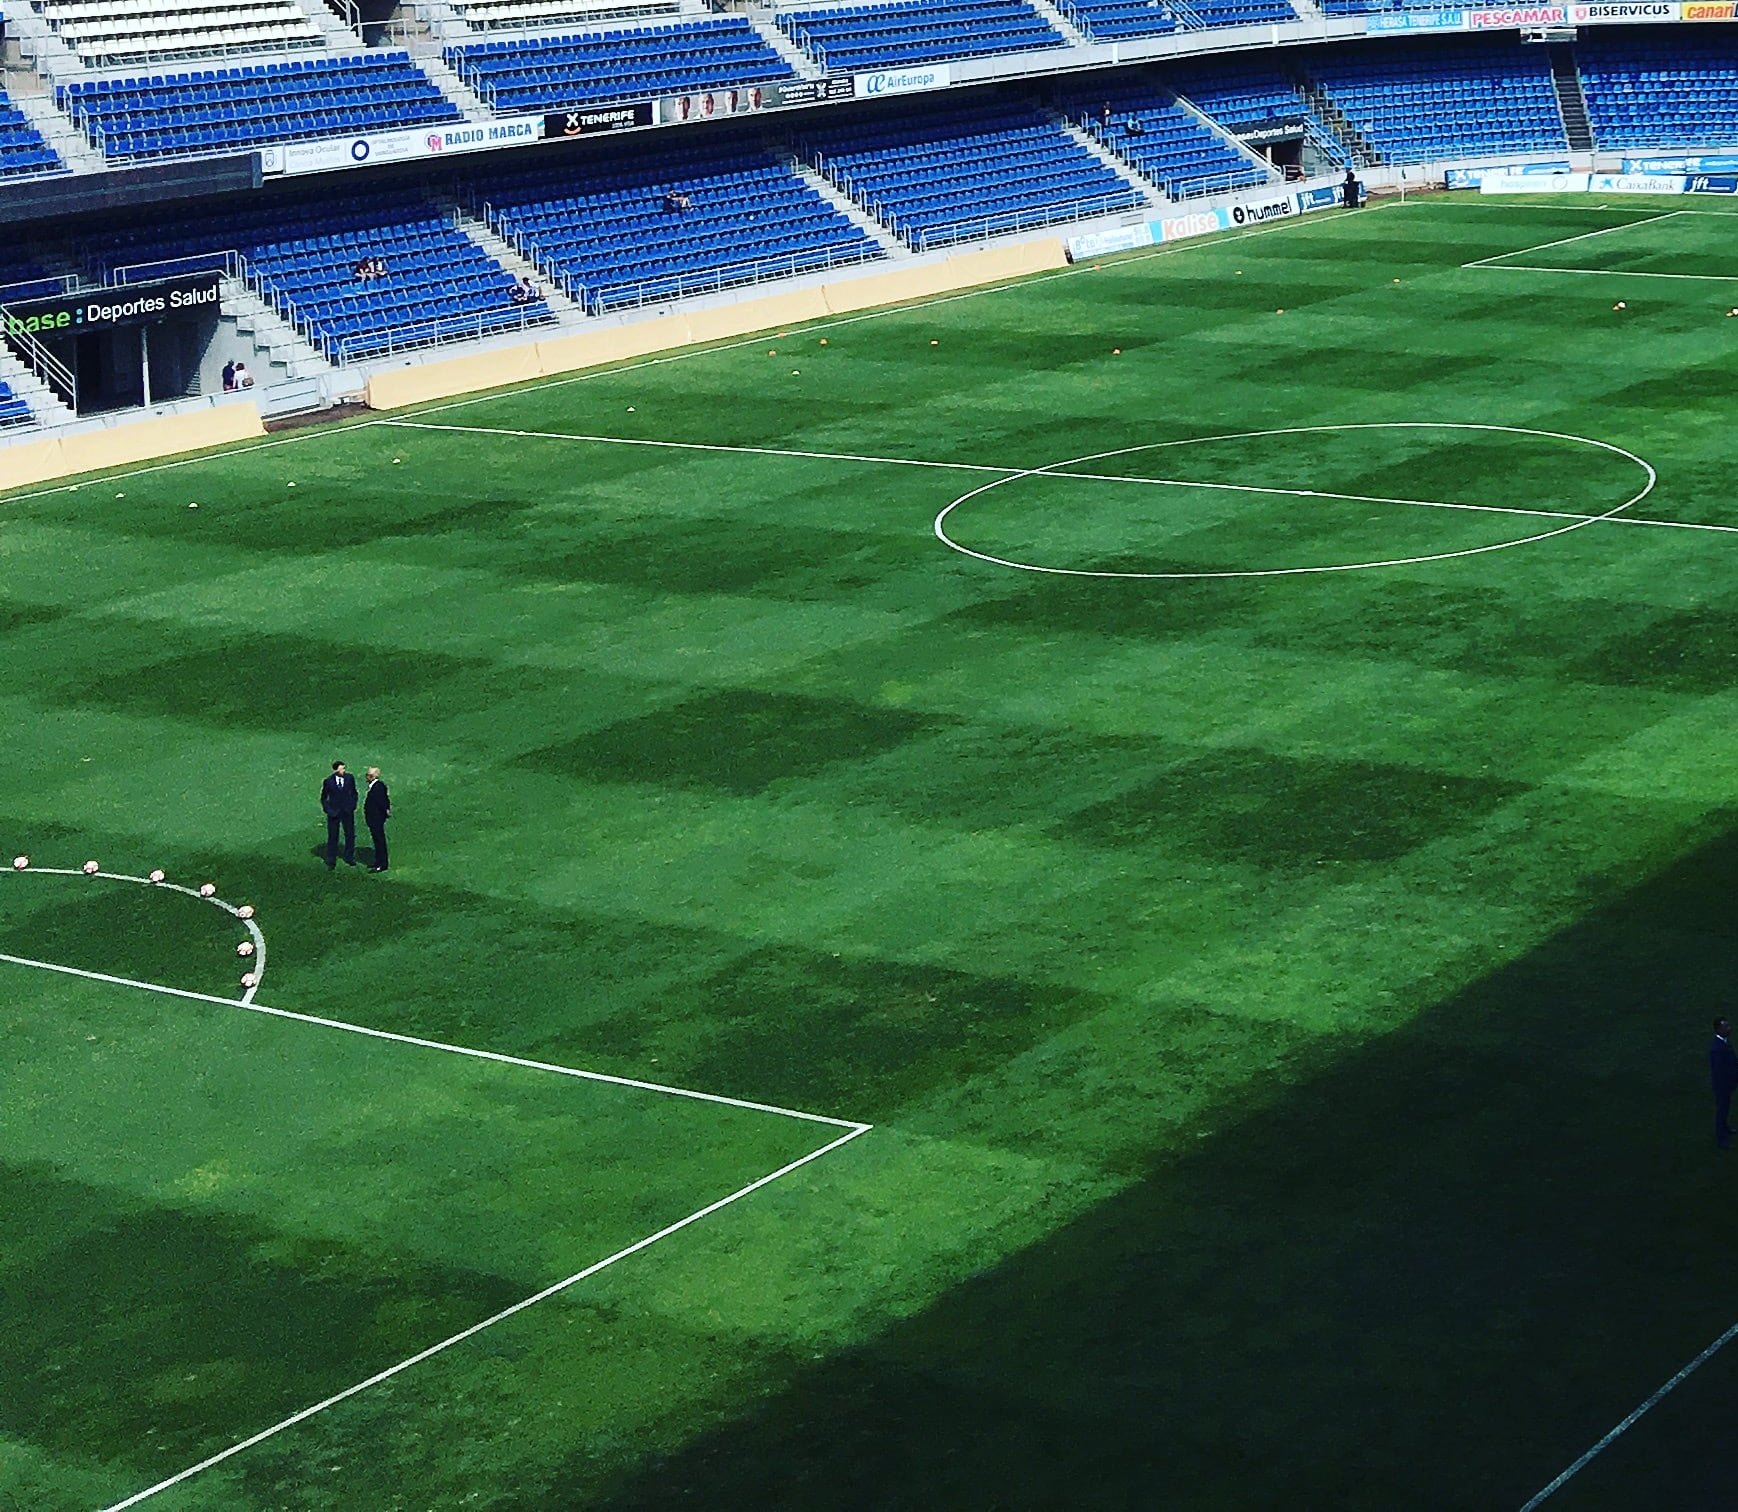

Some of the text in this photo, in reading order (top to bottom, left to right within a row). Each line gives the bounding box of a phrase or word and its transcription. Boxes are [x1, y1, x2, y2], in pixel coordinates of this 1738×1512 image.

[1472, 8, 1563, 25] PESCAMAR
[1589, 4, 1670, 17] BISERVICUS
[887, 72, 935, 87] AirEuropa
[581, 110, 635, 125] TENERIFE
[445, 129, 483, 146] RADIO
[489, 123, 532, 139] MARCA
[1616, 176, 1674, 191] CaixaBank
[1246, 196, 1292, 220] hummel
[1164, 212, 1218, 239] Kalise
[88, 295, 166, 323] Deportes
[170, 284, 218, 308] Salud
